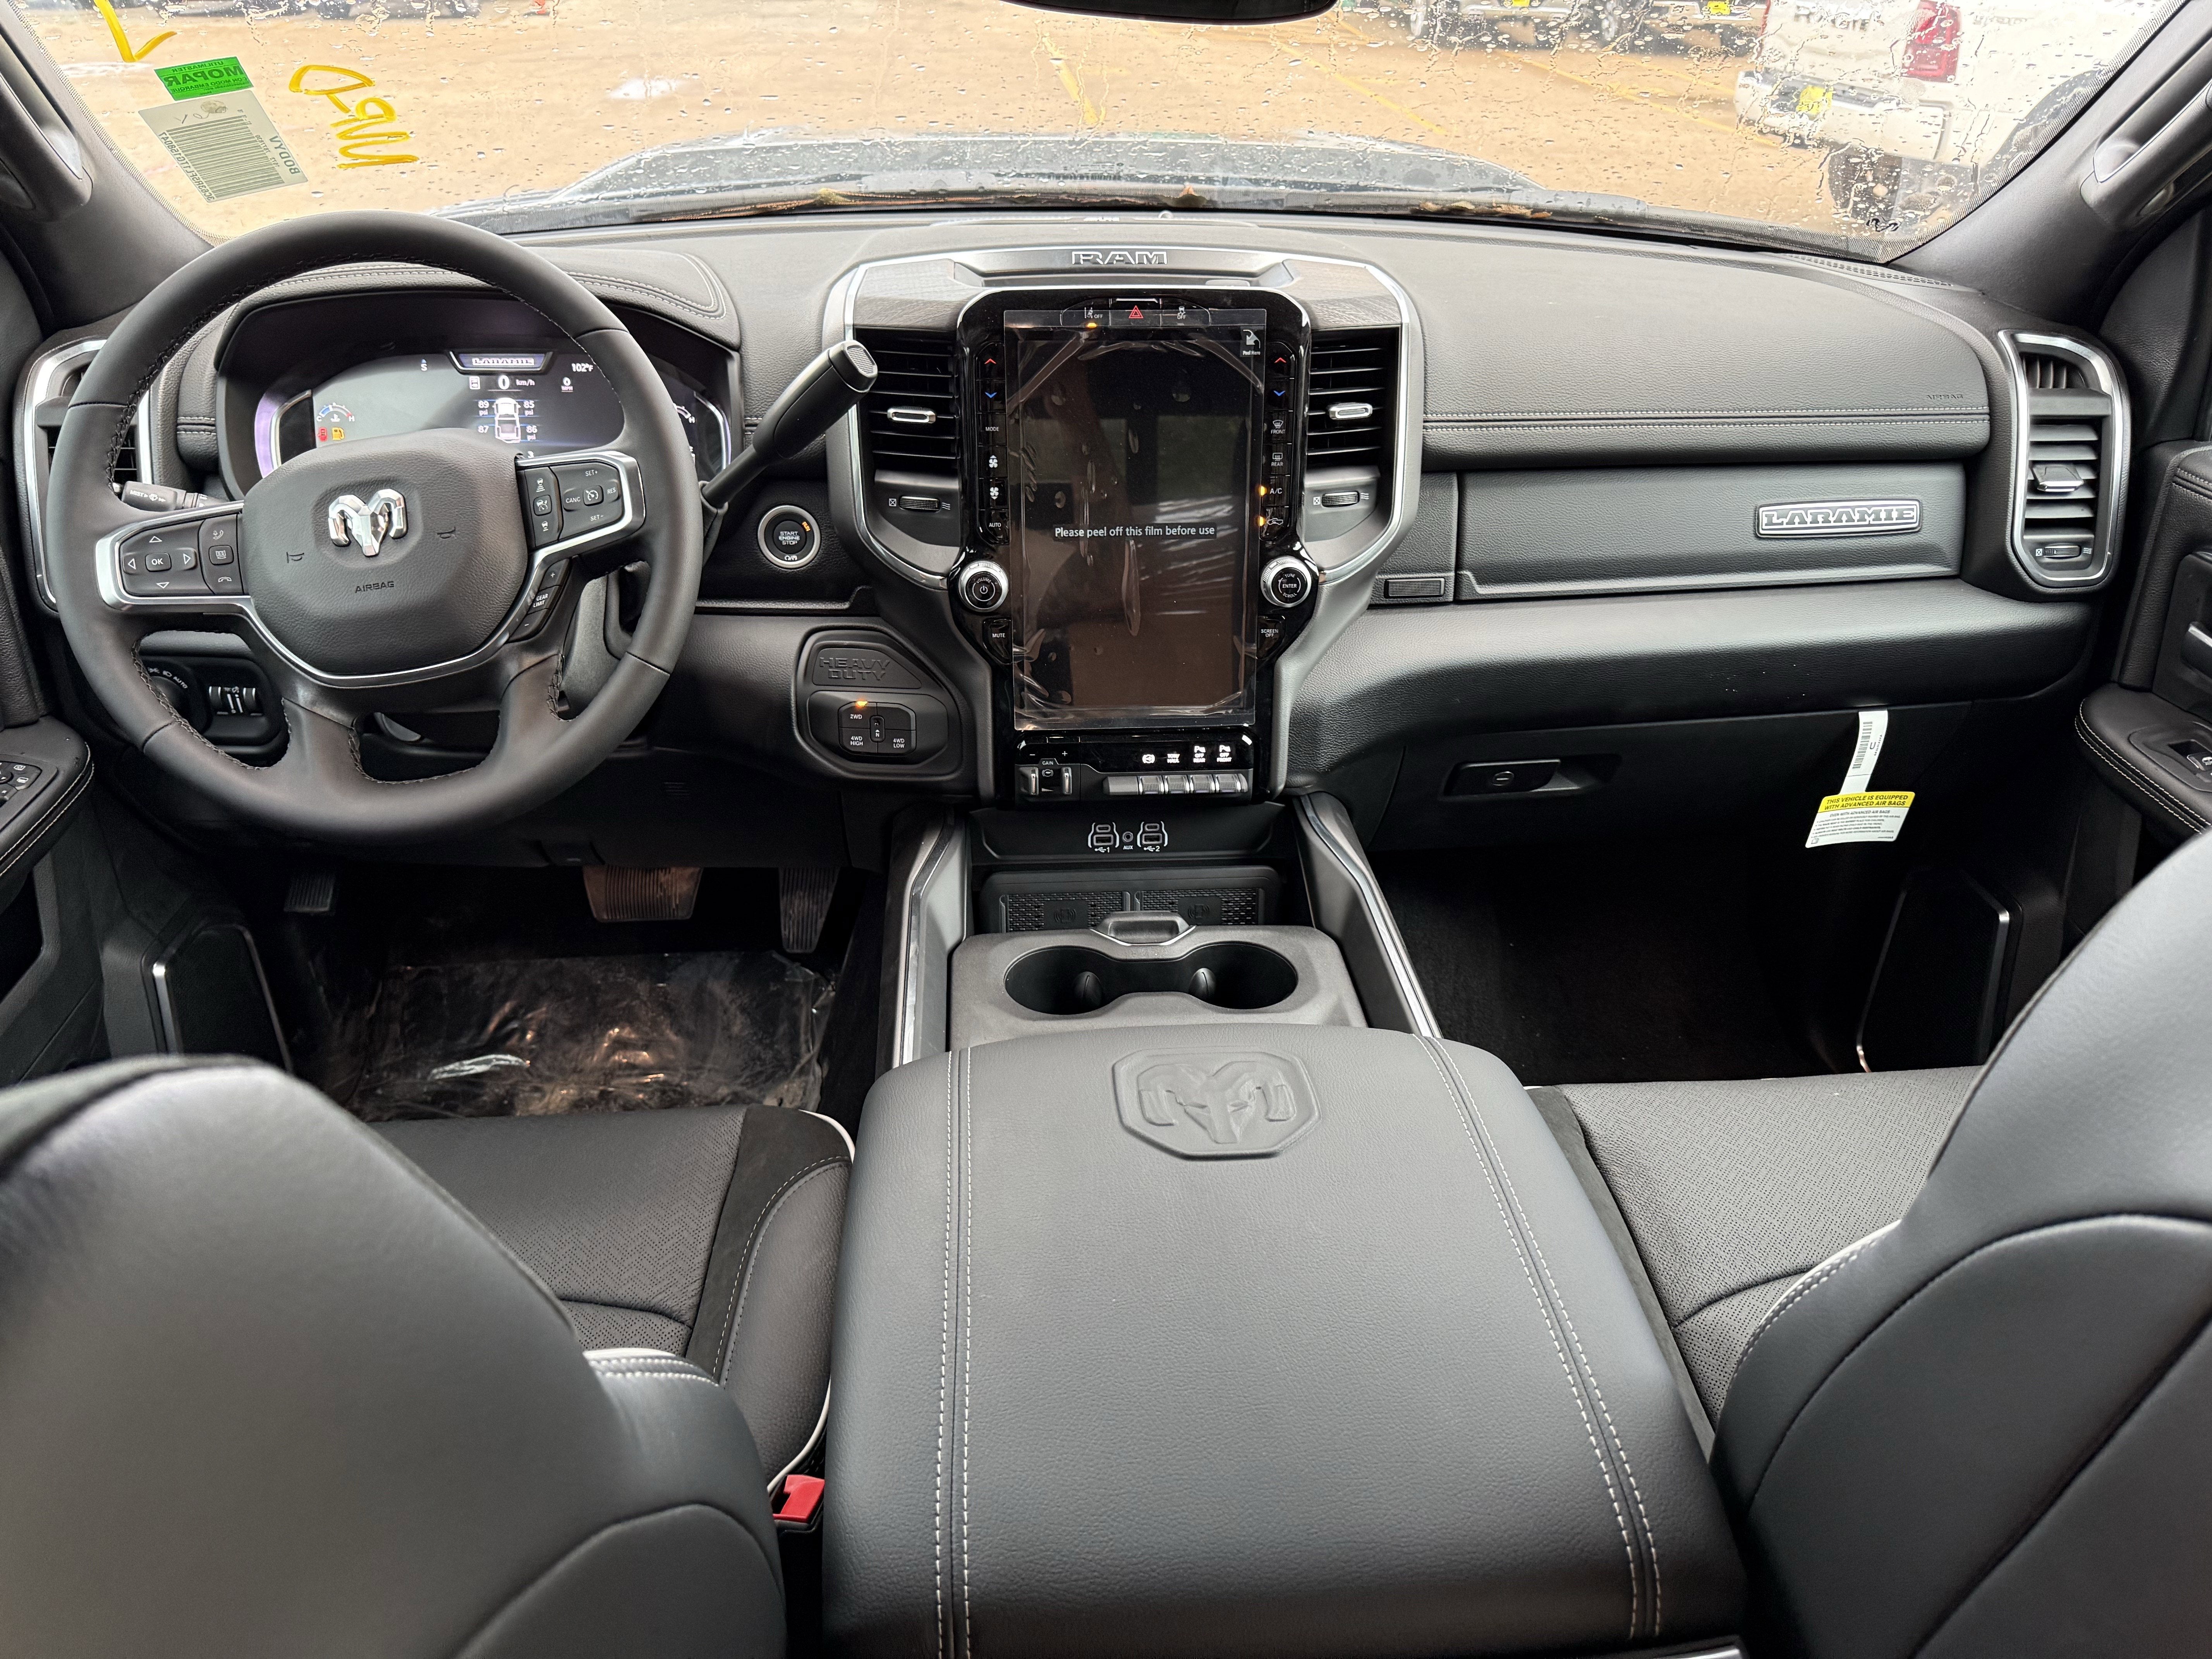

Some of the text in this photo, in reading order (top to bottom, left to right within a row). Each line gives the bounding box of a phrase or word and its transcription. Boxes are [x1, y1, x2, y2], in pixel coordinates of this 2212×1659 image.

[1072, 251, 1168, 265] RAM
[421, 363, 428, 371] S
[498, 375, 510, 390] 0
[563, 377, 571, 386] 0
[478, 400, 489, 409] 89
[523, 400, 535, 409] 85
[478, 425, 489, 434] 87
[526, 425, 538, 434] 86
[1762, 506, 1917, 529] LARAMIE
[1054, 525, 1215, 538] Please peel off this film before use
[355, 581, 395, 594] AIRBAG
[819, 657, 891, 670] HEAVY
[828, 669, 886, 680] DUTY
[173, 676, 188, 689] AUTO
